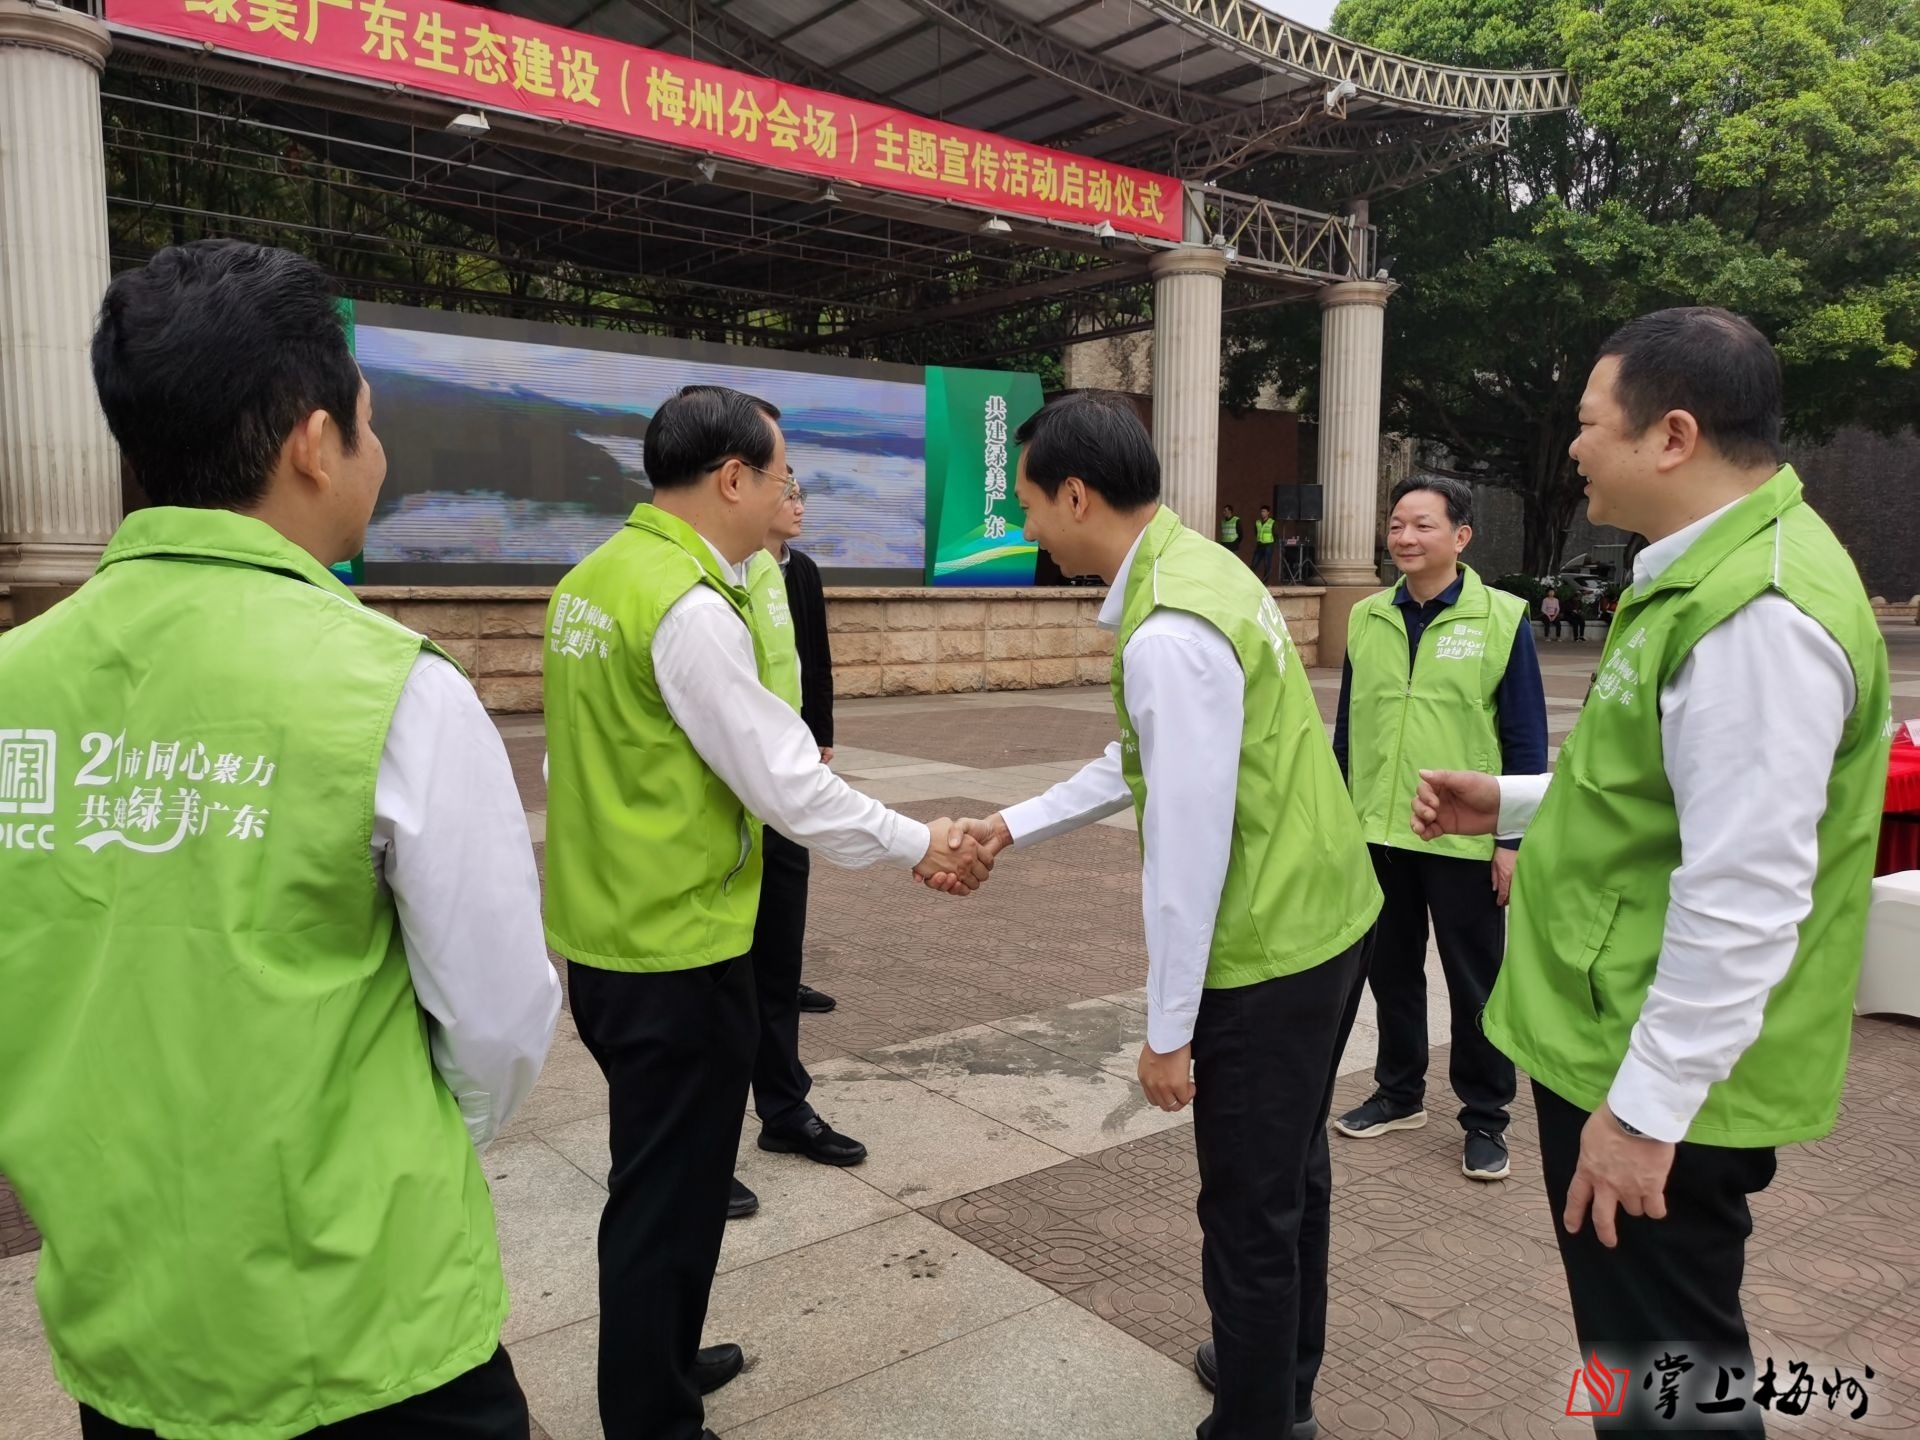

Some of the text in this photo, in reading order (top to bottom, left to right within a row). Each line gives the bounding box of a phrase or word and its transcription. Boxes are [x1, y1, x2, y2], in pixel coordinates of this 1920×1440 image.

[984, 395, 1008, 538] 共建绿美广东
[74, 728, 276, 787] 21市同心聚力
[75, 786, 270, 853] 共建绿美广东
